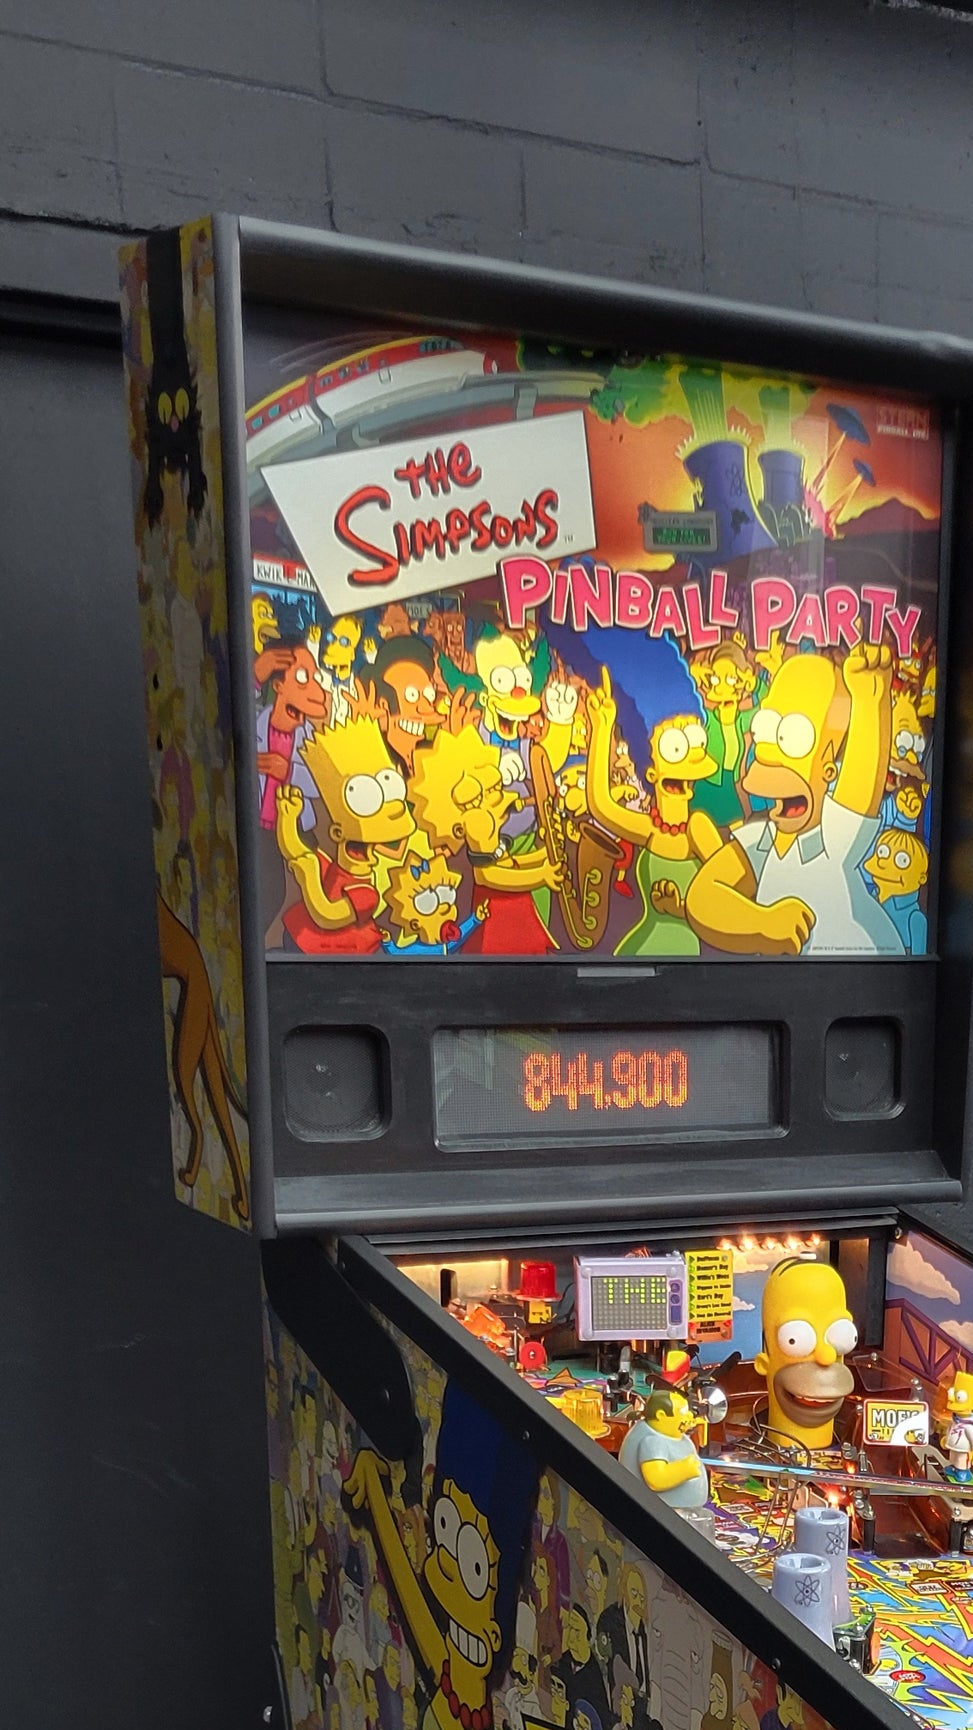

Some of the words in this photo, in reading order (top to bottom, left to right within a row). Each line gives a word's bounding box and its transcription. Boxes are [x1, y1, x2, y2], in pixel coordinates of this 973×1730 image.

[498, 554, 739, 651] PINBALL
[750, 575, 922, 659] PARTY
[603, 1277, 667, 1304] THE
